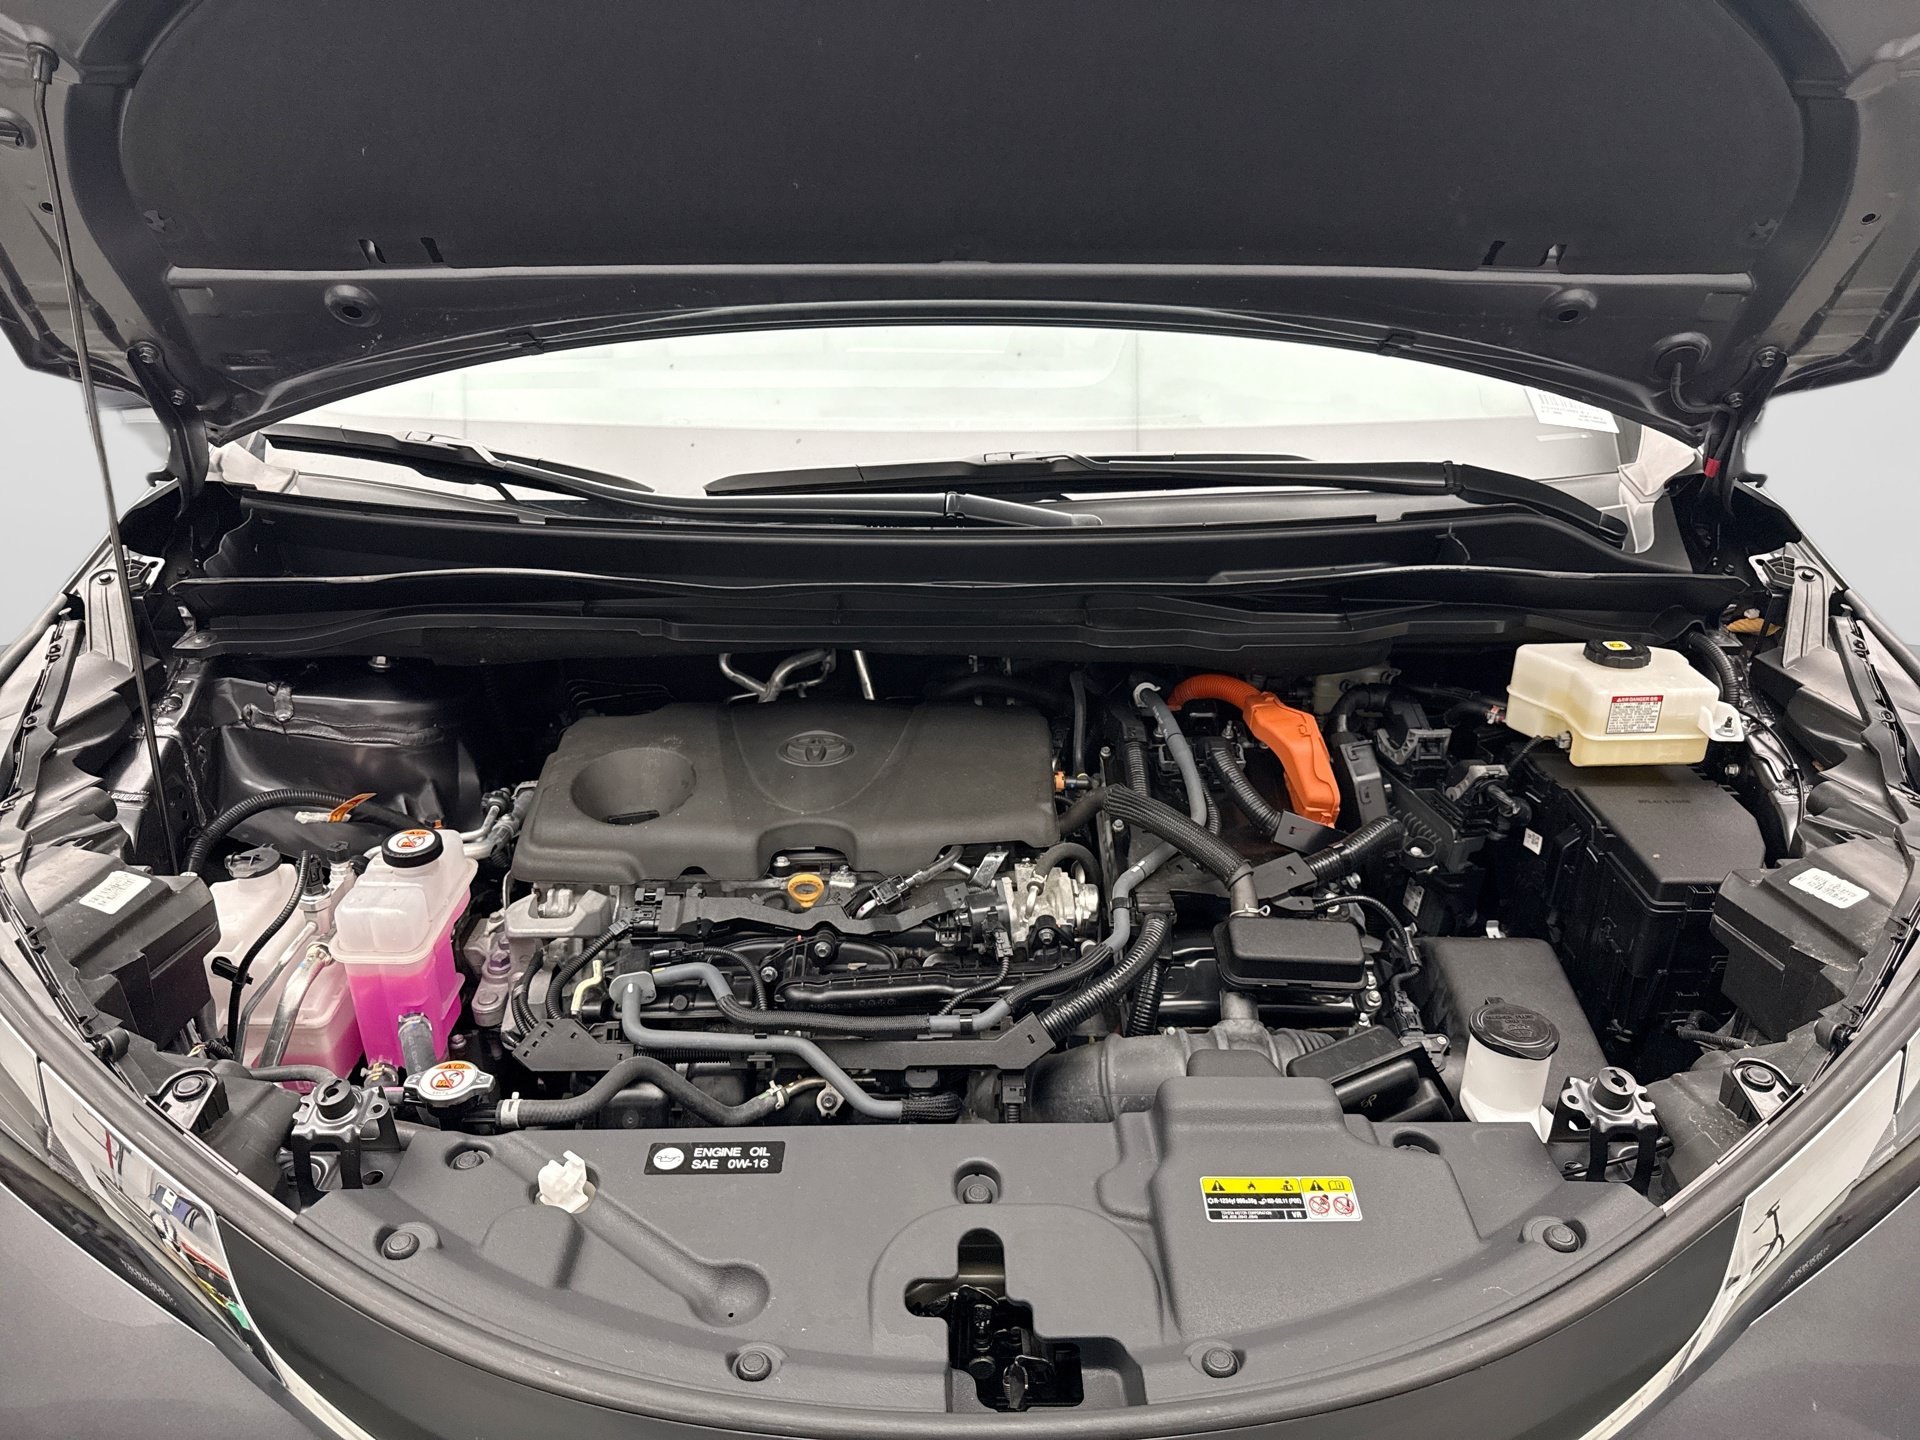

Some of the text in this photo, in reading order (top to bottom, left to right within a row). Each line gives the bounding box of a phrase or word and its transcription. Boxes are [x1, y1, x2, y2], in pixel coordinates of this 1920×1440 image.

[693, 1146, 771, 1157] ENGINE OIL
[691, 1158, 769, 1169] SAE 0W-16
